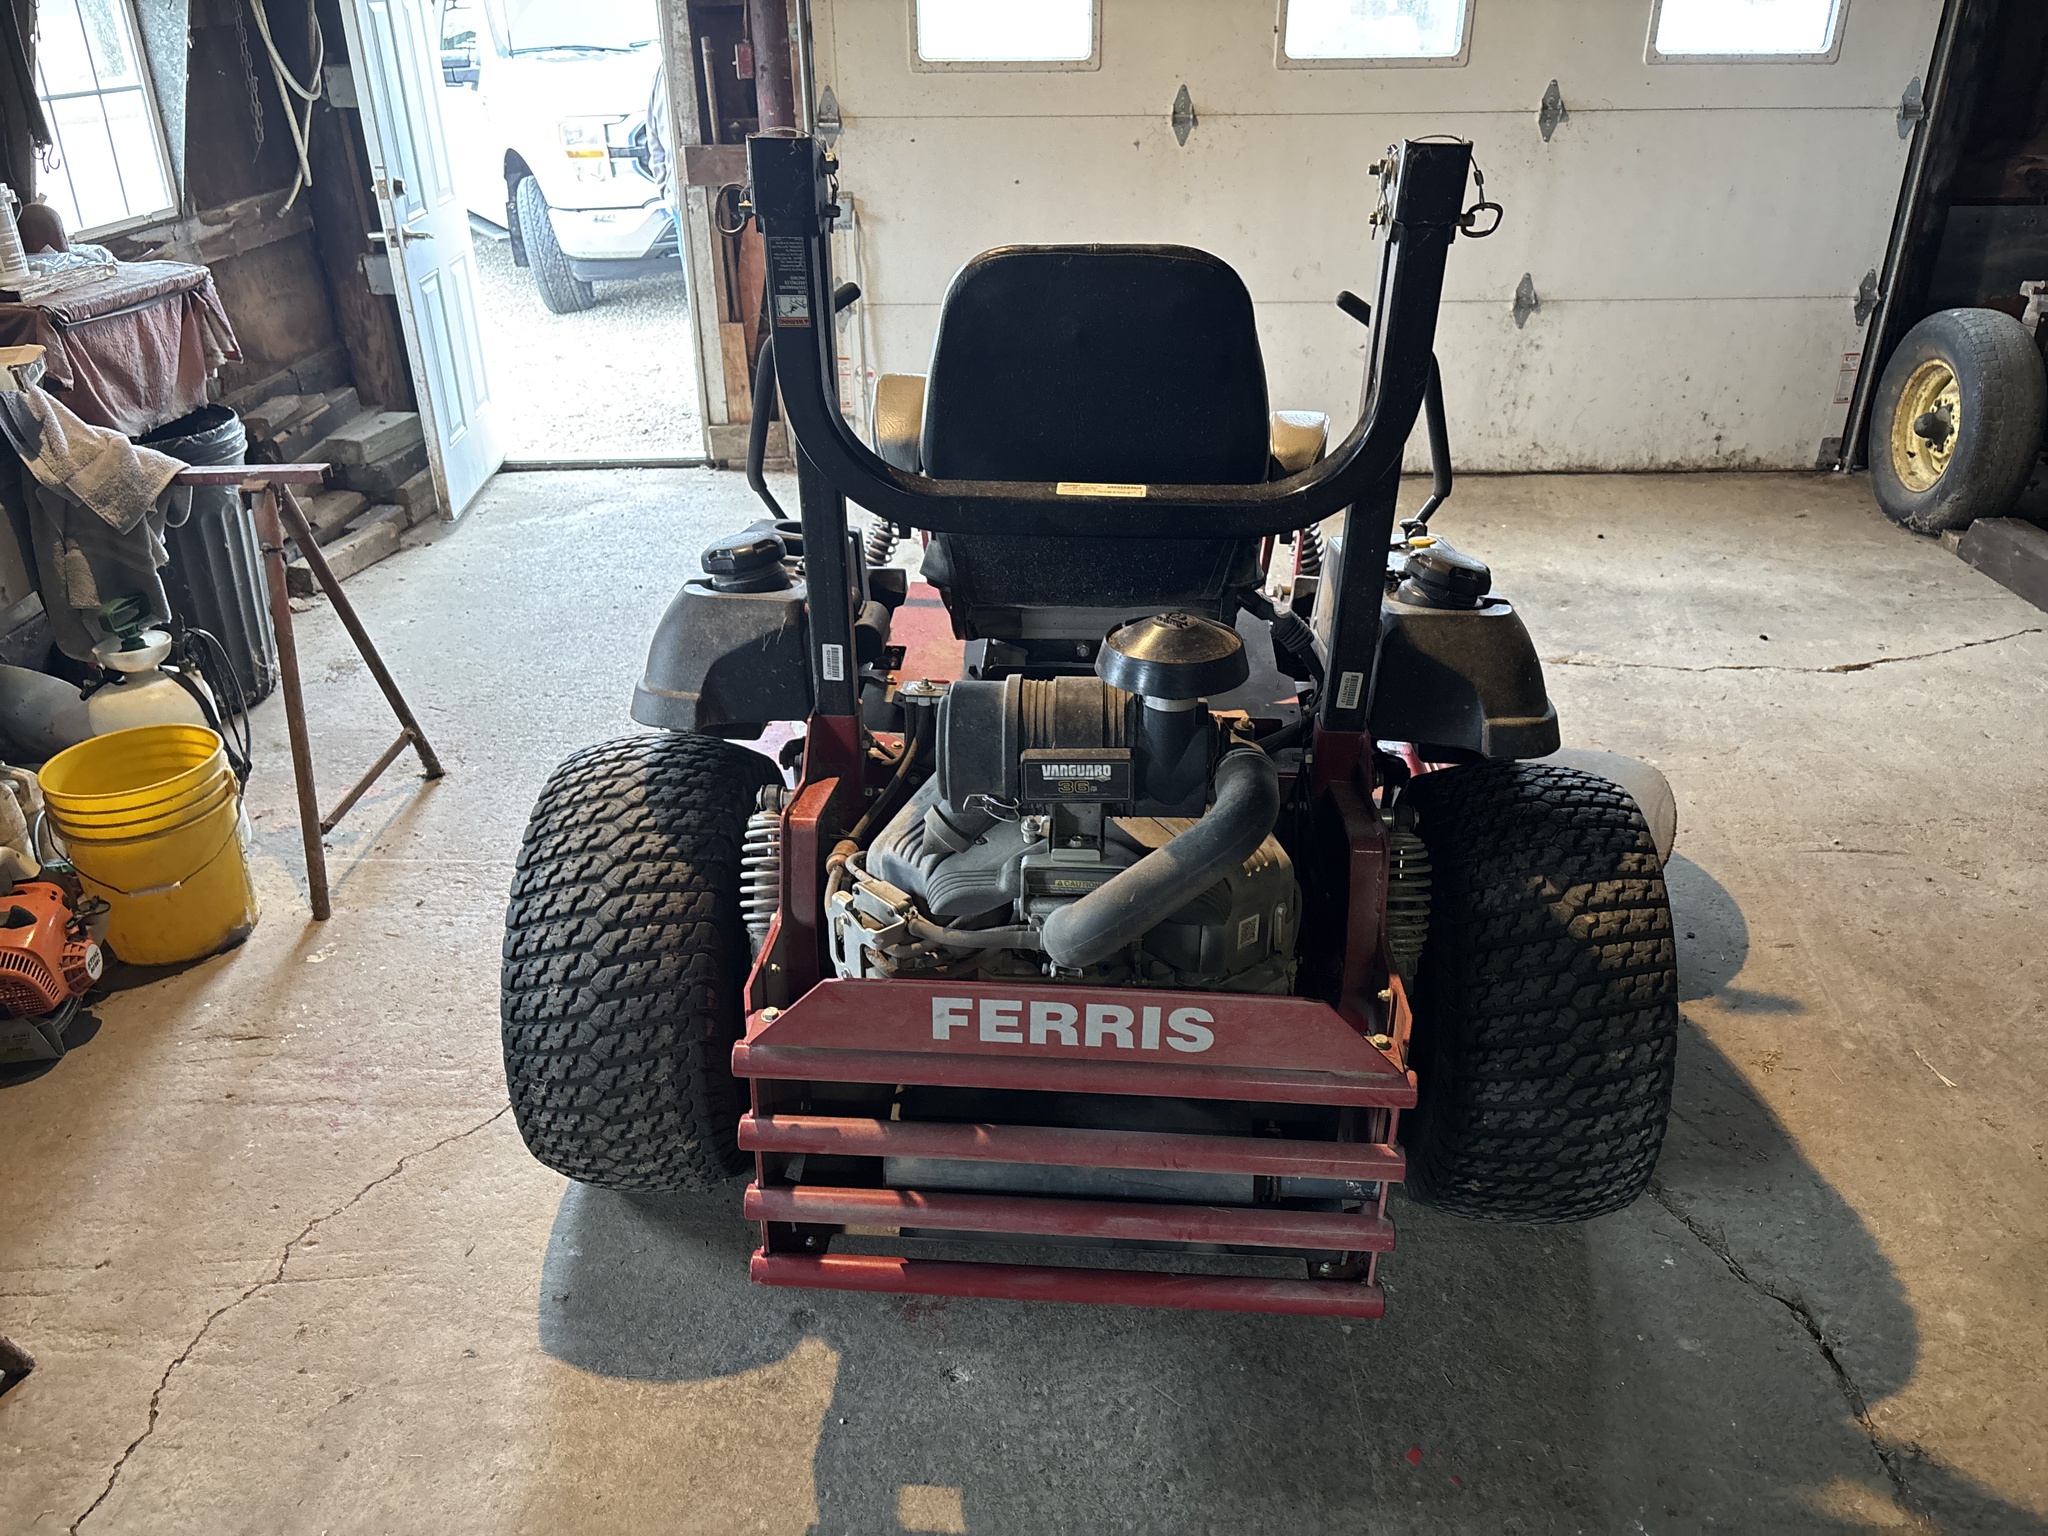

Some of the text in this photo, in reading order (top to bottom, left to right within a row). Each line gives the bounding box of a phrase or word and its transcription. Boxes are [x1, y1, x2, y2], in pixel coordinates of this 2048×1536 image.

[1041, 764, 1112, 777] VANGUARD
[1058, 780, 1090, 794] 36
[1064, 880, 1101, 889] CAUTION
[931, 997, 1216, 1053] FERRIS
